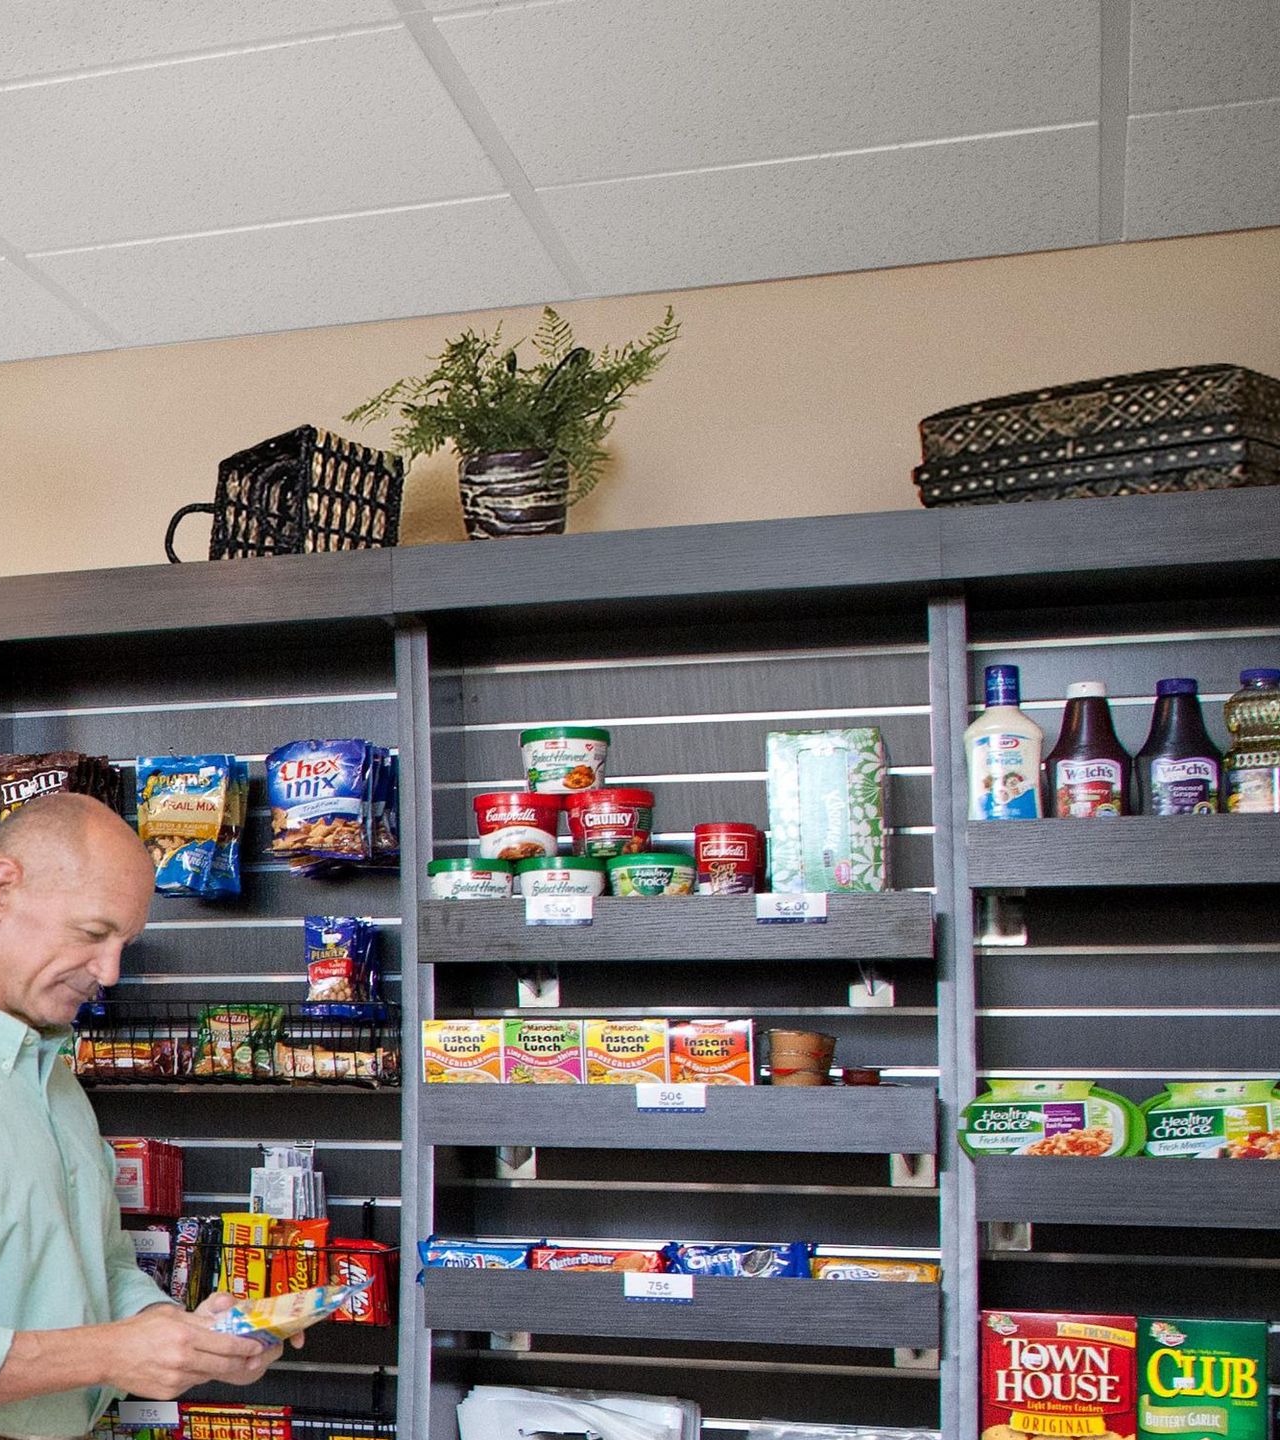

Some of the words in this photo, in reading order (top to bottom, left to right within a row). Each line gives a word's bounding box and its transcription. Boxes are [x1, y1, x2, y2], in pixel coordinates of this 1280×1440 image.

[281, 754, 342, 783] Chex
[285, 772, 337, 800] mix
[196, 799, 217, 812] MIX
[583, 812, 633, 828] CHUNKY
[438, 1033, 486, 1043] Instant
[517, 1033, 566, 1043] Instant
[600, 1033, 650, 1043] Instant
[684, 1036, 736, 1048] Instant
[444, 1043, 481, 1053] Lunch
[524, 1043, 561, 1053] Lunch
[606, 1043, 645, 1053] Lunch
[690, 1047, 730, 1057] Lunch
[659, 1091, 683, 1101] 50¢
[972, 1116, 1031, 1133] Choice
[1160, 1112, 1215, 1131] Healthy
[1152, 1122, 1213, 1140] Choice
[977, 1135, 999, 1145] Fresh
[1157, 1141, 1182, 1153] Fresh
[647, 1281, 670, 1290] 75¢
[1002, 1337, 1112, 1375] TOWN
[1145, 1347, 1259, 1399] CLUB
[996, 1368, 1121, 1404] HOUSE
[1026, 1400, 1046, 1412] Light
[1021, 1413, 1095, 1434] ORIGINAL
[1145, 1410, 1187, 1428] BUTTERY
[1187, 1411, 1221, 1428] GARLIC
